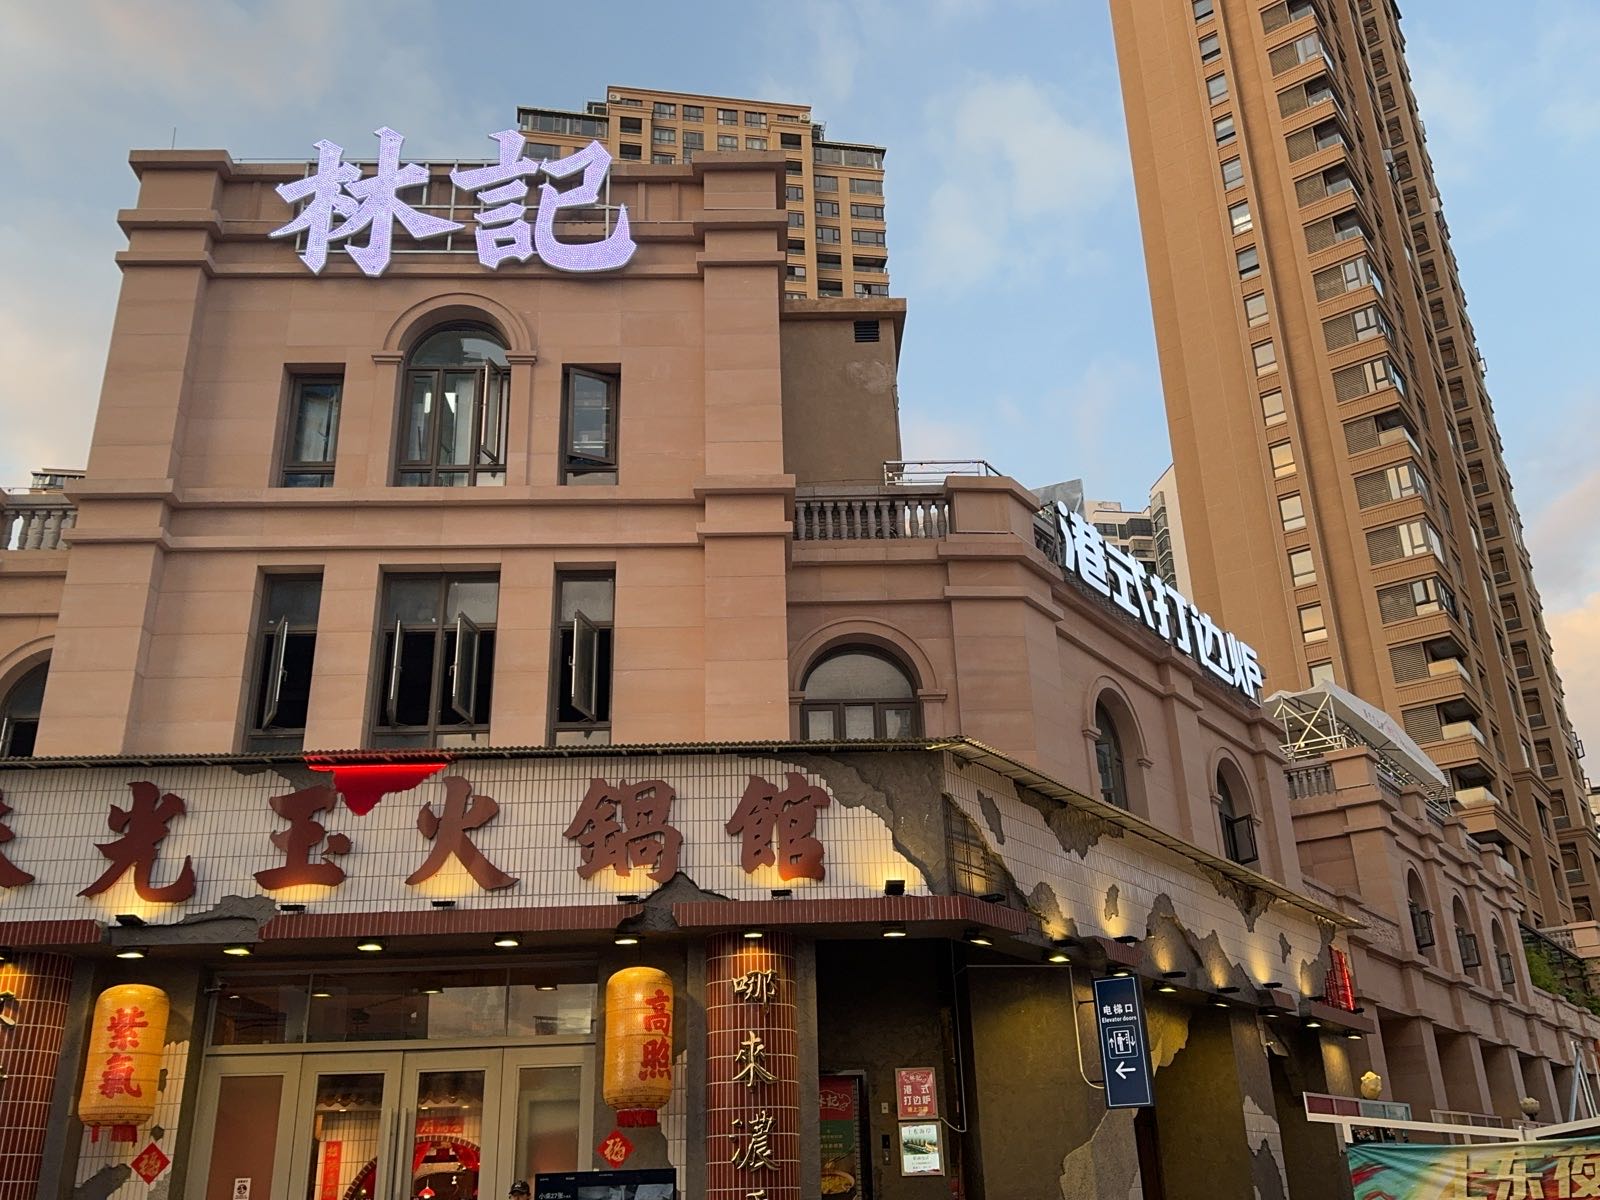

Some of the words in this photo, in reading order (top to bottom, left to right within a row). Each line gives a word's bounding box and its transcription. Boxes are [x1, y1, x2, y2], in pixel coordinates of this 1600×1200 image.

[268, 126, 637, 278] 林記
[1057, 500, 1264, 699] 港式打边炉
[0, 771, 831, 904] 光玉火鍋館
[98, 1006, 149, 1099] 紫氣
[638, 988, 672, 1082] 高照
[1101, 1016, 1123, 1024] Elevator
[1103, 1003, 1134, 1016] 电梯口
[729, 968, 781, 1200] 哪來濃
[903, 1095, 931, 1106] 打边炉
